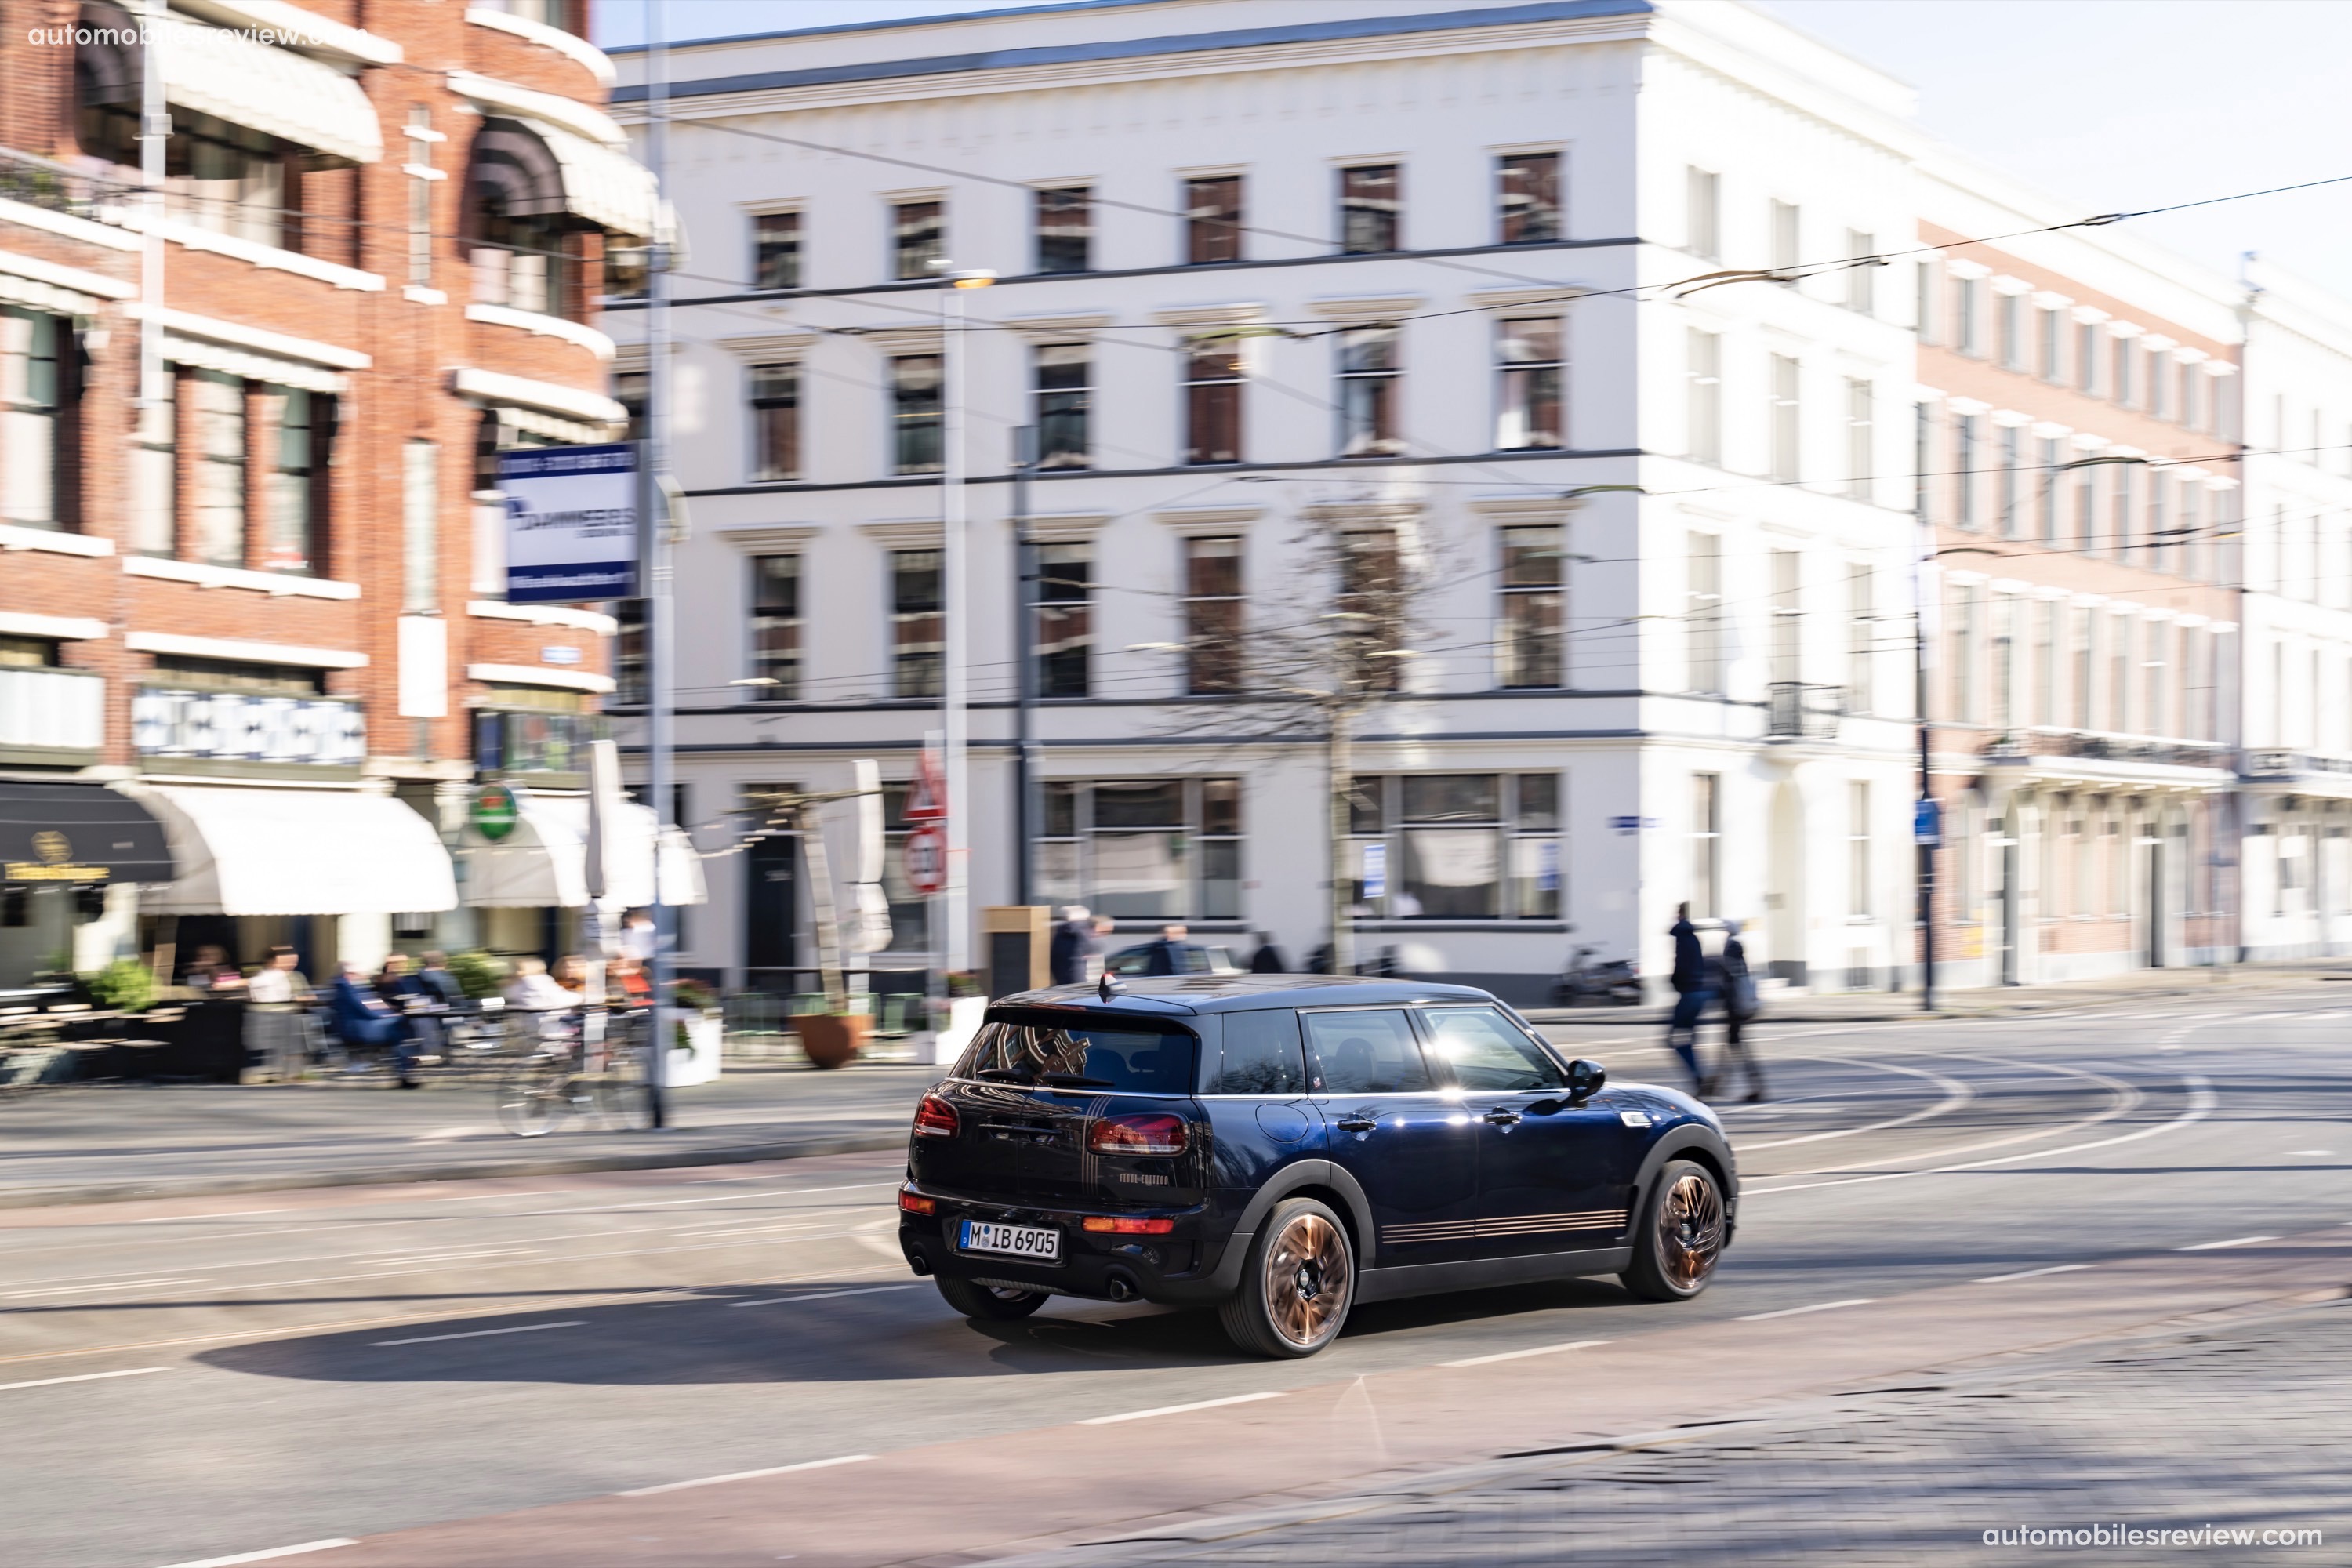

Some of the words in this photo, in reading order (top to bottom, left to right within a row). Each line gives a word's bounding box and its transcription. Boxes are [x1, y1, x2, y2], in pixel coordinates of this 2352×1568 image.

[970, 1225, 982, 1247] M
[991, 1227, 1011, 1249] IB
[1014, 1229, 1056, 1254] 6905
